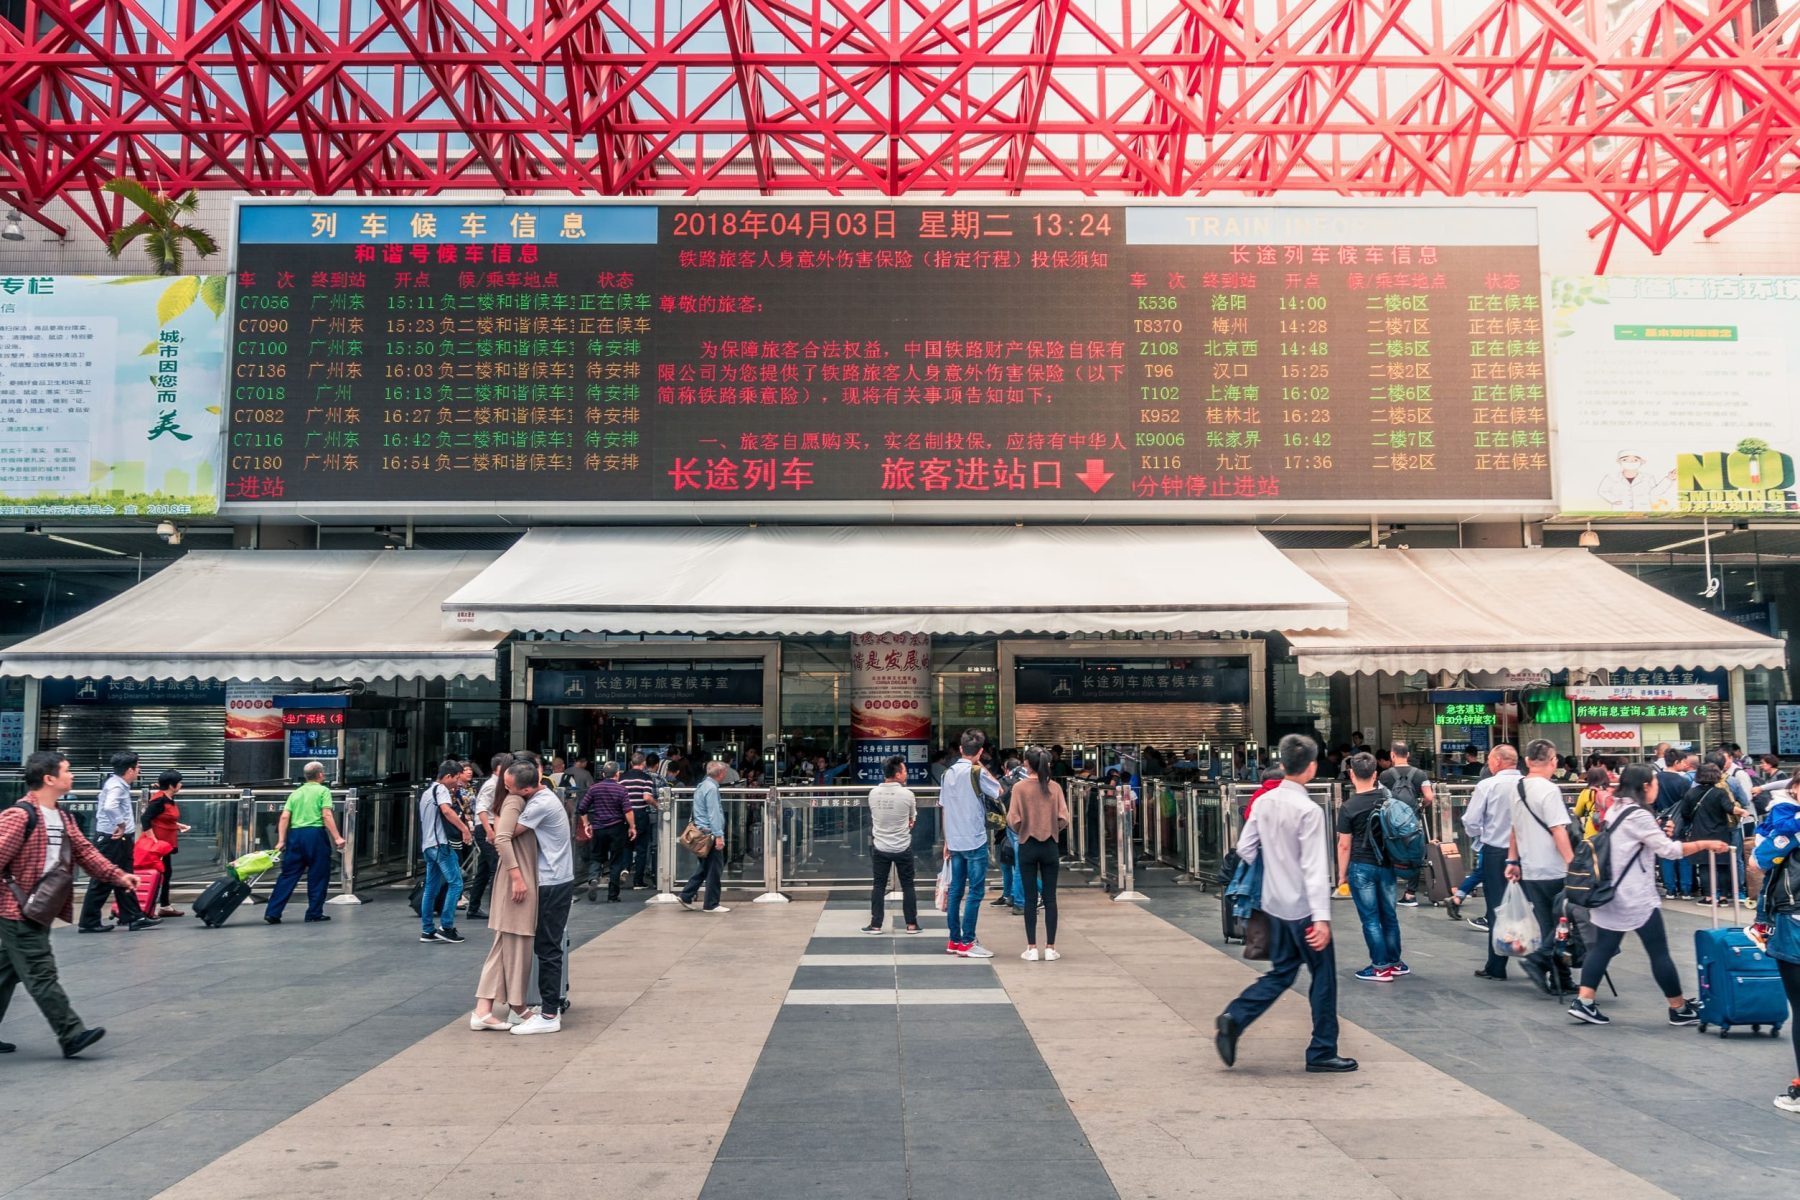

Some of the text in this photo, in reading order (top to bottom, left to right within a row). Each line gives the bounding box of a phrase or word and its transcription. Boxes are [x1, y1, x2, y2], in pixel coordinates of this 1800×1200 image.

[311, 213, 587, 239] 列车候车信息
[673, 210, 1112, 240] 2018年04月03日 星期二 13:24
[1185, 217, 1271, 238] TRAIN
[355, 244, 539, 264] 和谐号候车信息
[679, 249, 1108, 269] 铁路旅客人身意外伤害保险（指定行程）投保须知
[1229, 245, 1439, 265] 长途列车候车信息
[0, 277, 54, 294] 专栏
[311, 272, 366, 289] 终到站
[394, 272, 431, 289] 开点
[458, 272, 560, 289] 候/乘车地点
[598, 272, 634, 289] 状态
[1202, 272, 1257, 290] 终到站
[1285, 272, 1321, 290] 开点
[1348, 272, 1447, 290] 候/乘车地点
[1484, 272, 1520, 290] 状态
[240, 295, 289, 311] C7056
[311, 295, 365, 311] 广州东
[387, 295, 434, 311] 15:11
[579, 295, 651, 311] 正在候车
[658, 294, 763, 314] 尊敬的旅客：
[1138, 295, 1540, 312] K536 洛阳 14:00 二楼6区 正在候车
[239, 318, 288, 334] C7090
[309, 318, 364, 334] 广州东
[387, 318, 434, 334] 15:23
[578, 318, 651, 334] 正在候车
[1134, 318, 1542, 335] T8370 梅州 14:28 二楼7区 正在候车
[238, 340, 287, 357] C7100
[309, 340, 363, 357] 广州东
[386, 340, 433, 357] 15:50
[586, 340, 641, 357] 待安排
[700, 340, 1125, 360] 为保障旅客合法权益，中国铁路财产保险自保有
[1139, 340, 1542, 357] Z108 北京西 14:48 二楼5区 正在候车
[237, 363, 286, 379] C7136
[307, 363, 362, 379] 广州东
[385, 363, 433, 379] 16:03
[586, 363, 640, 379] 待安排
[657, 363, 1125, 383] 限公司为您提供了铁路旅客人身意外伤害保险（以下
[1145, 362, 1543, 380] T96 汉口 15:25 二楼2区 正在候车
[236, 386, 285, 402] C7018
[316, 386, 352, 402] 广州
[385, 386, 432, 402] 16:13
[586, 386, 640, 402] 待安排
[657, 386, 1053, 405] 简称铁路乘意险），现将有关事项告知如下：
[1140, 385, 1544, 402] T102 上海南 16:02 二楼6区 正在候车
[234, 408, 284, 424] C7082
[306, 408, 361, 424] 广州东
[384, 408, 431, 424] 16:27
[585, 408, 640, 424] 待安排
[1141, 407, 1545, 425] K952 桂林北 16:23 二楼5区 正在候车
[233, 432, 283, 448] C7116
[305, 432, 360, 448] 广州东
[383, 432, 431, 448] 16:42
[585, 432, 640, 448] 待安排
[699, 433, 1127, 451] 一、旅客自愿购买，实名制投保，应持有中华人
[1135, 431, 1546, 448] K9006 张家界 16:42 二楼7区 正在候车
[232, 455, 282, 471] C7180
[304, 455, 359, 471] 广州东
[382, 455, 430, 471] 16:54
[584, 455, 639, 471] 待安排
[1141, 454, 1547, 471] K116 九江 17:36 二楼2区 正在候车
[1677, 451, 1795, 490] NO
[667, 457, 1062, 491] 长途列车 旅客进站口
[1132, 475, 1280, 498] 分钟停止进站
[1678, 490, 1790, 501] SMOKING
[147, 504, 191, 515] 2018年
[595, 676, 729, 690] 长途列车旅客候车室
[1082, 675, 1216, 689] 长途列车旅客候车室
[1446, 704, 1485, 714] 急客通道
[821, 799, 861, 807] 旅客止步
